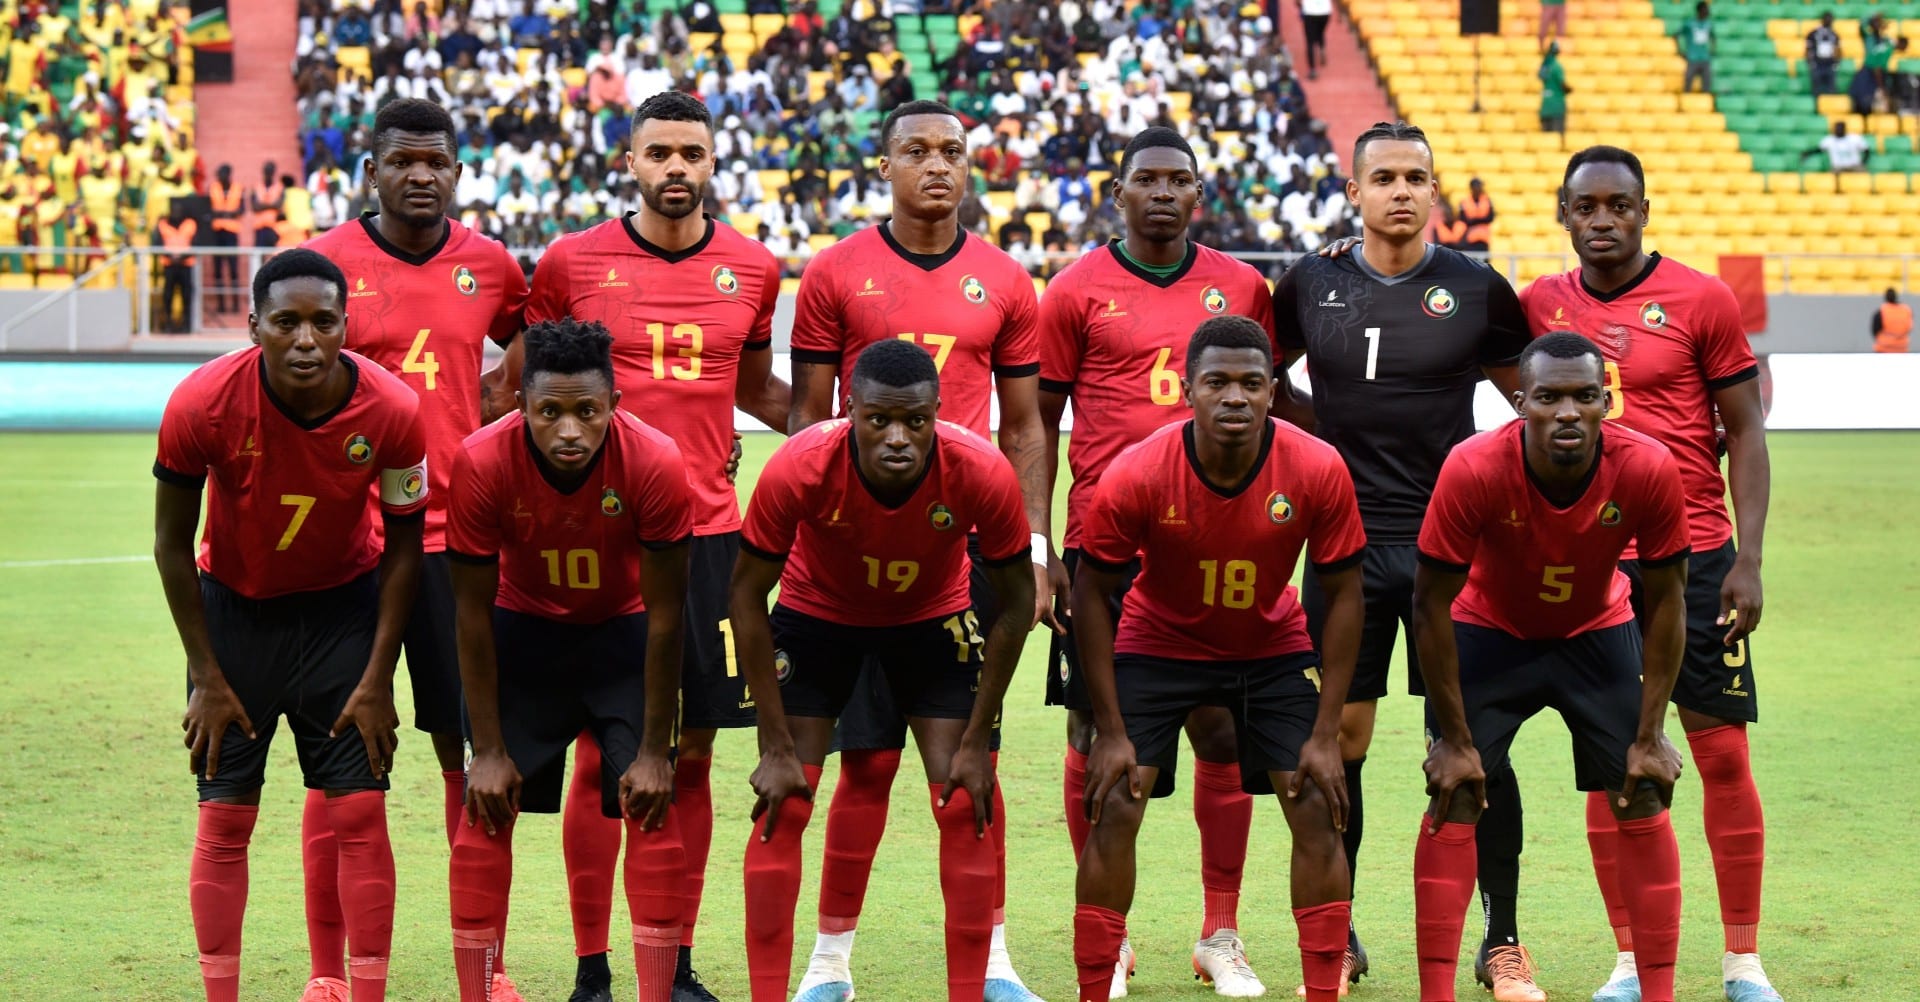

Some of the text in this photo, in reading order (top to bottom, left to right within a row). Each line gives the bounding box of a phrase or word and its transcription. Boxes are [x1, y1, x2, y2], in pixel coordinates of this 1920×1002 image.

[401, 328, 440, 391] 4
[646, 322, 704, 381] 13
[898, 332, 957, 376] 7
[1149, 347, 1180, 406] 6
[1364, 327, 1381, 380] 1
[275, 494, 317, 551] 7
[540, 548, 600, 590] 10
[862, 555, 920, 593] 19
[1199, 559, 1257, 610] 18
[1538, 565, 1576, 603] 5
